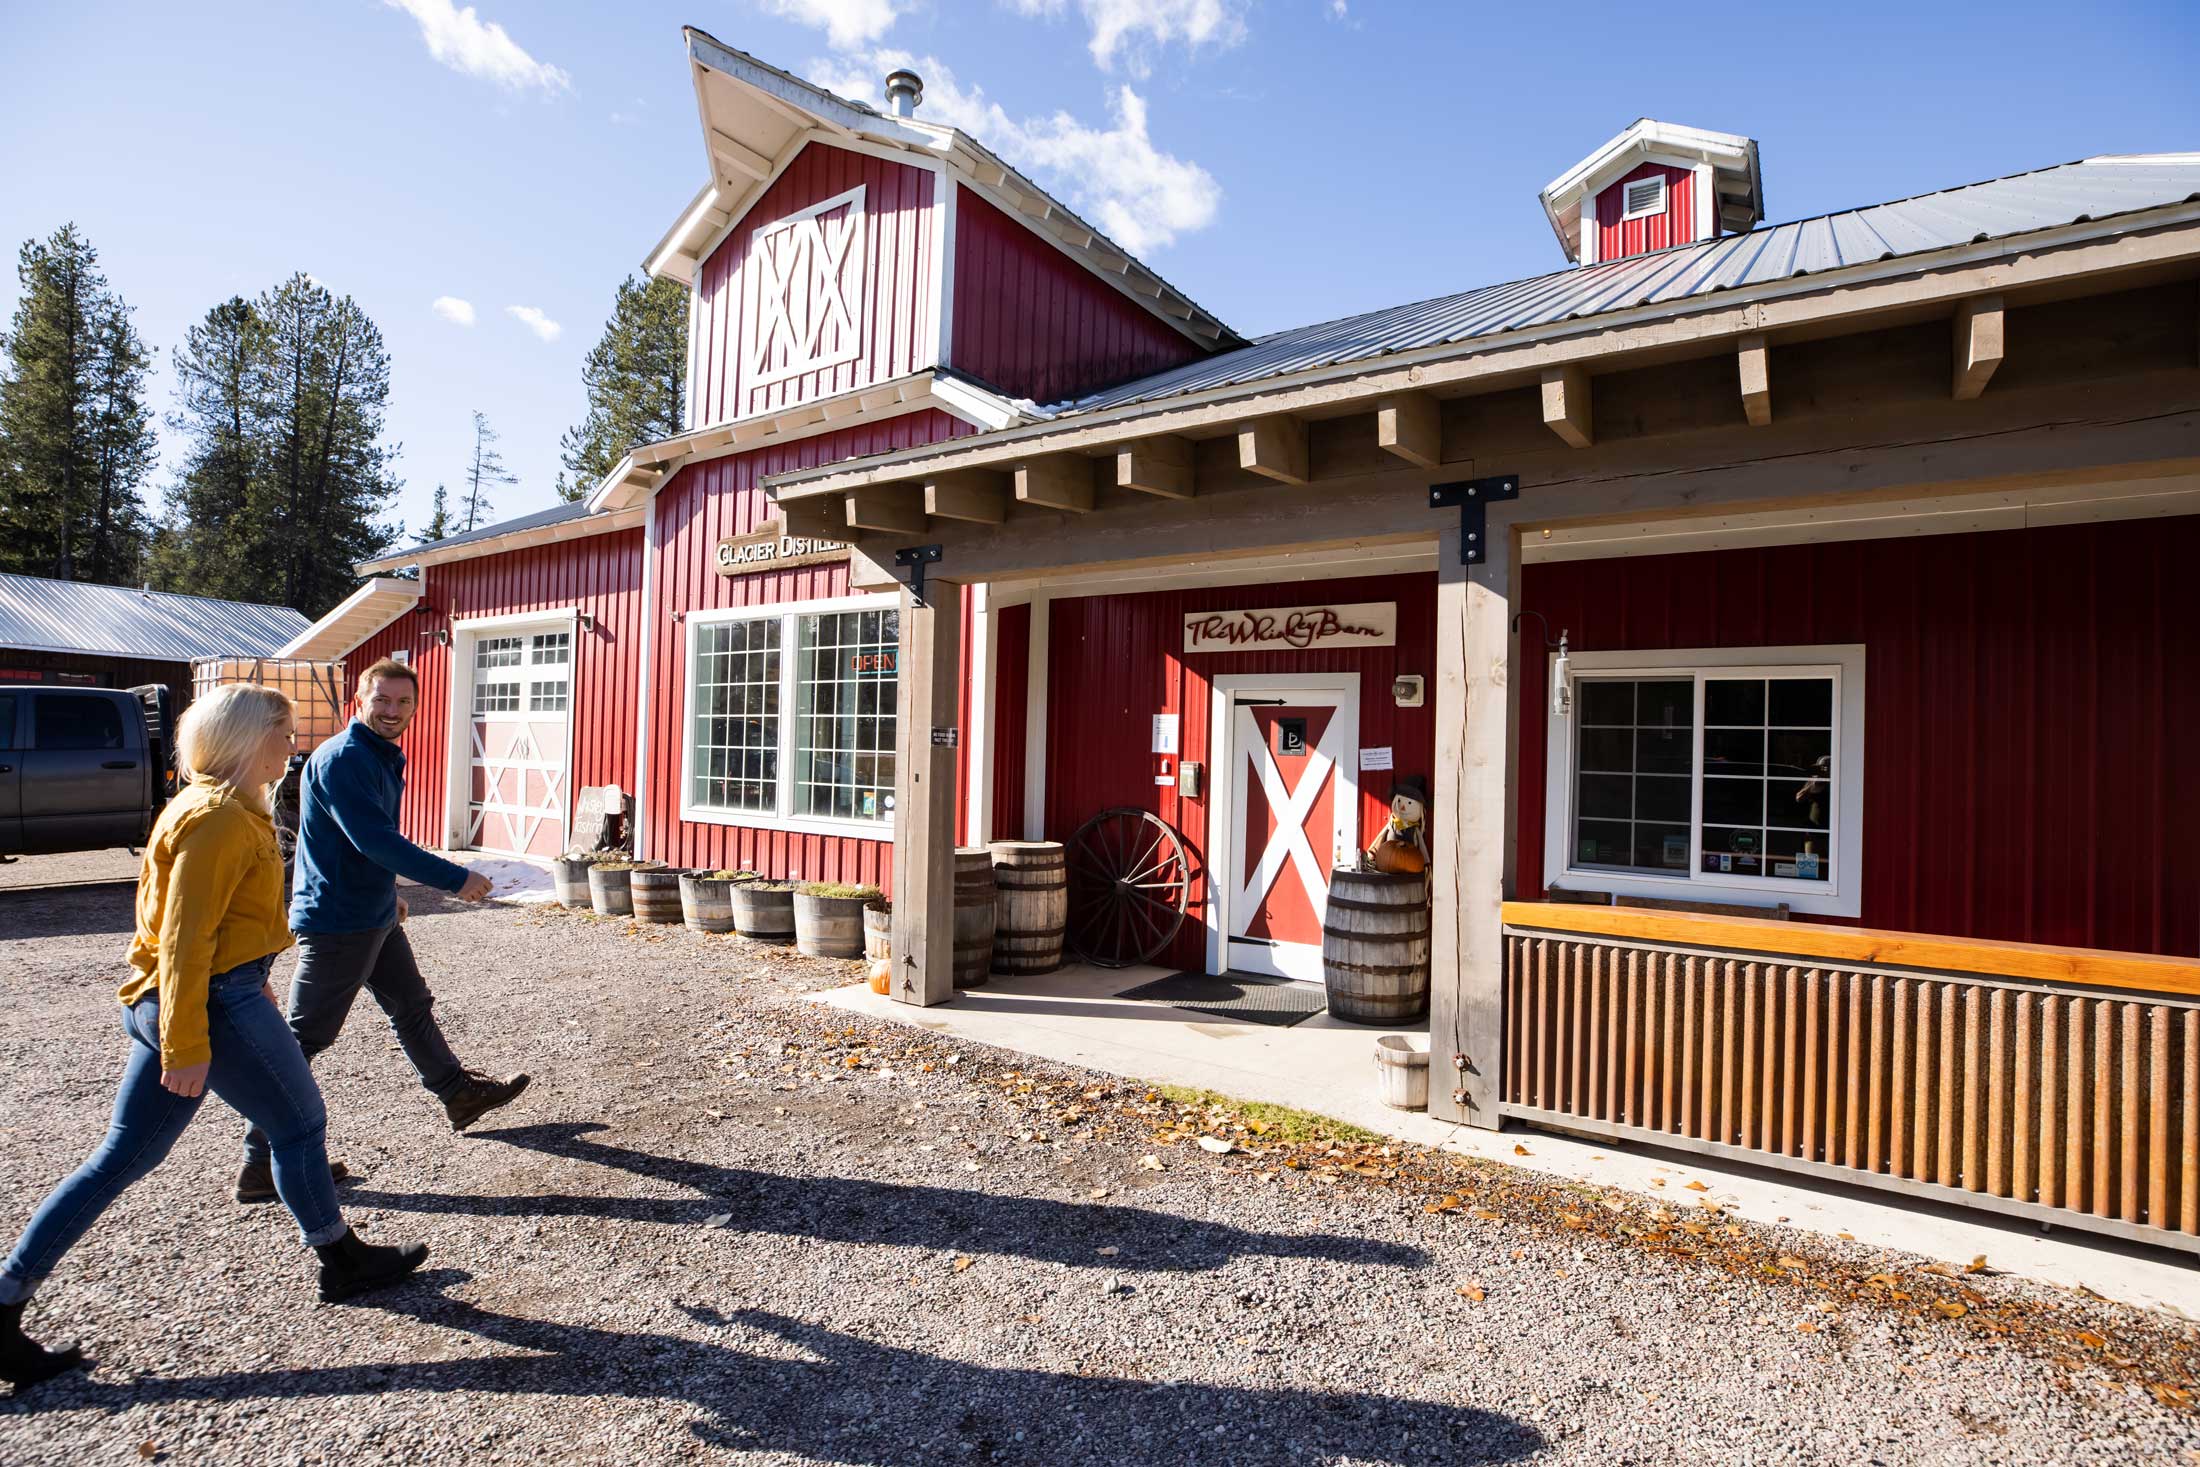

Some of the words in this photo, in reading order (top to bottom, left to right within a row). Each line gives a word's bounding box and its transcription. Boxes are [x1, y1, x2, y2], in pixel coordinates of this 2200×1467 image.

[717, 542, 777, 566] GLACIER
[1186, 616, 1228, 646] The
[1224, 612, 1319, 648] Whiskey
[1305, 609, 1384, 640] Barn
[851, 653, 895, 671] OPEN
